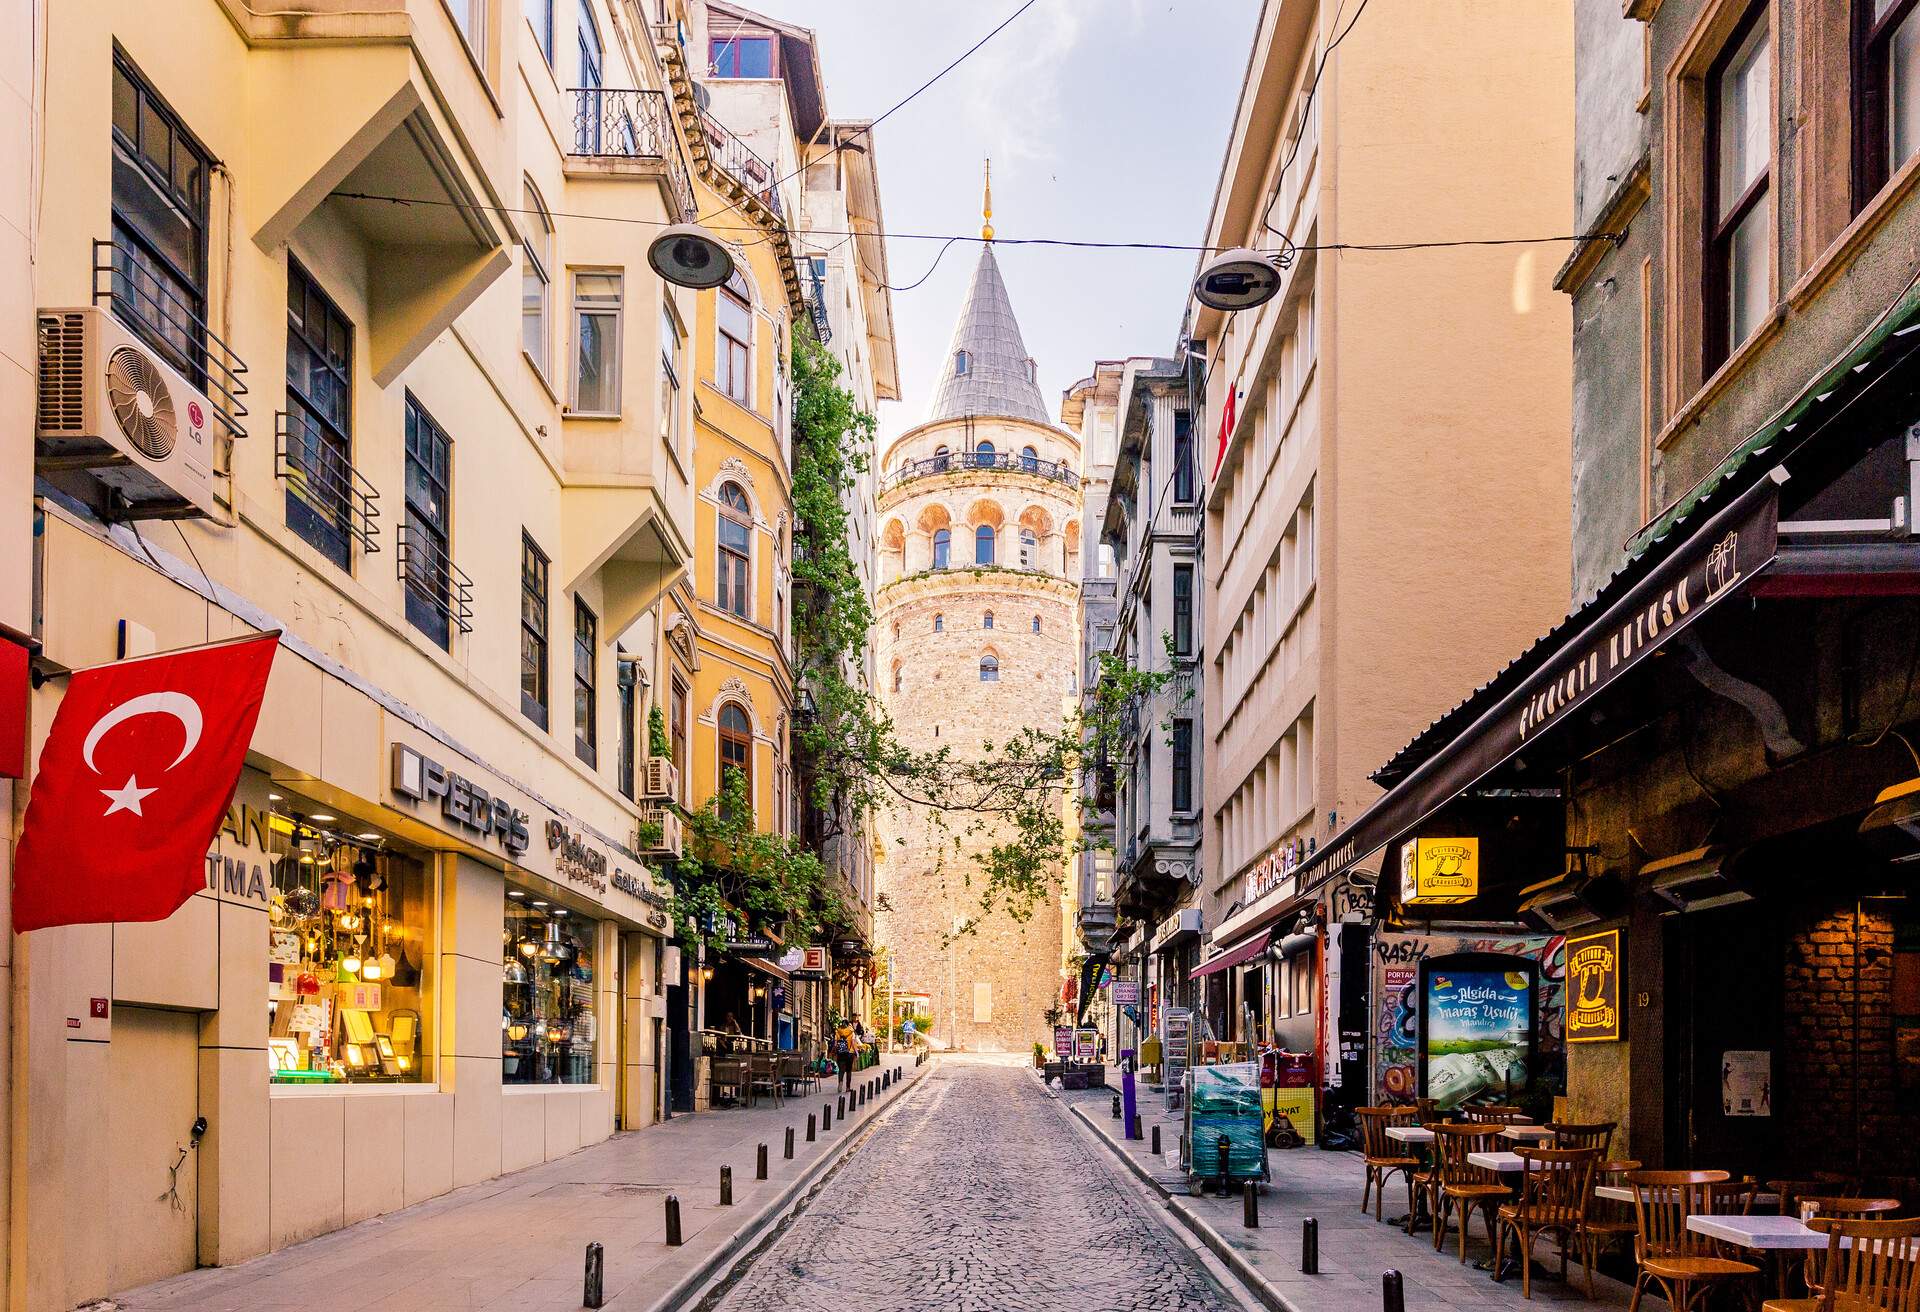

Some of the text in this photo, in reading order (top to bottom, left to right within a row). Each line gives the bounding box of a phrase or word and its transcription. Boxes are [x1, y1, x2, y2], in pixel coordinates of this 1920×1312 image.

[189, 427, 202, 446] LG
[1610, 576, 1690, 669] KUTUSU
[206, 852, 267, 902] TMA
[1458, 986, 1497, 1004] Algida
[1639, 991, 1649, 1007] 19
[1482, 1004, 1519, 1021] Usulü
